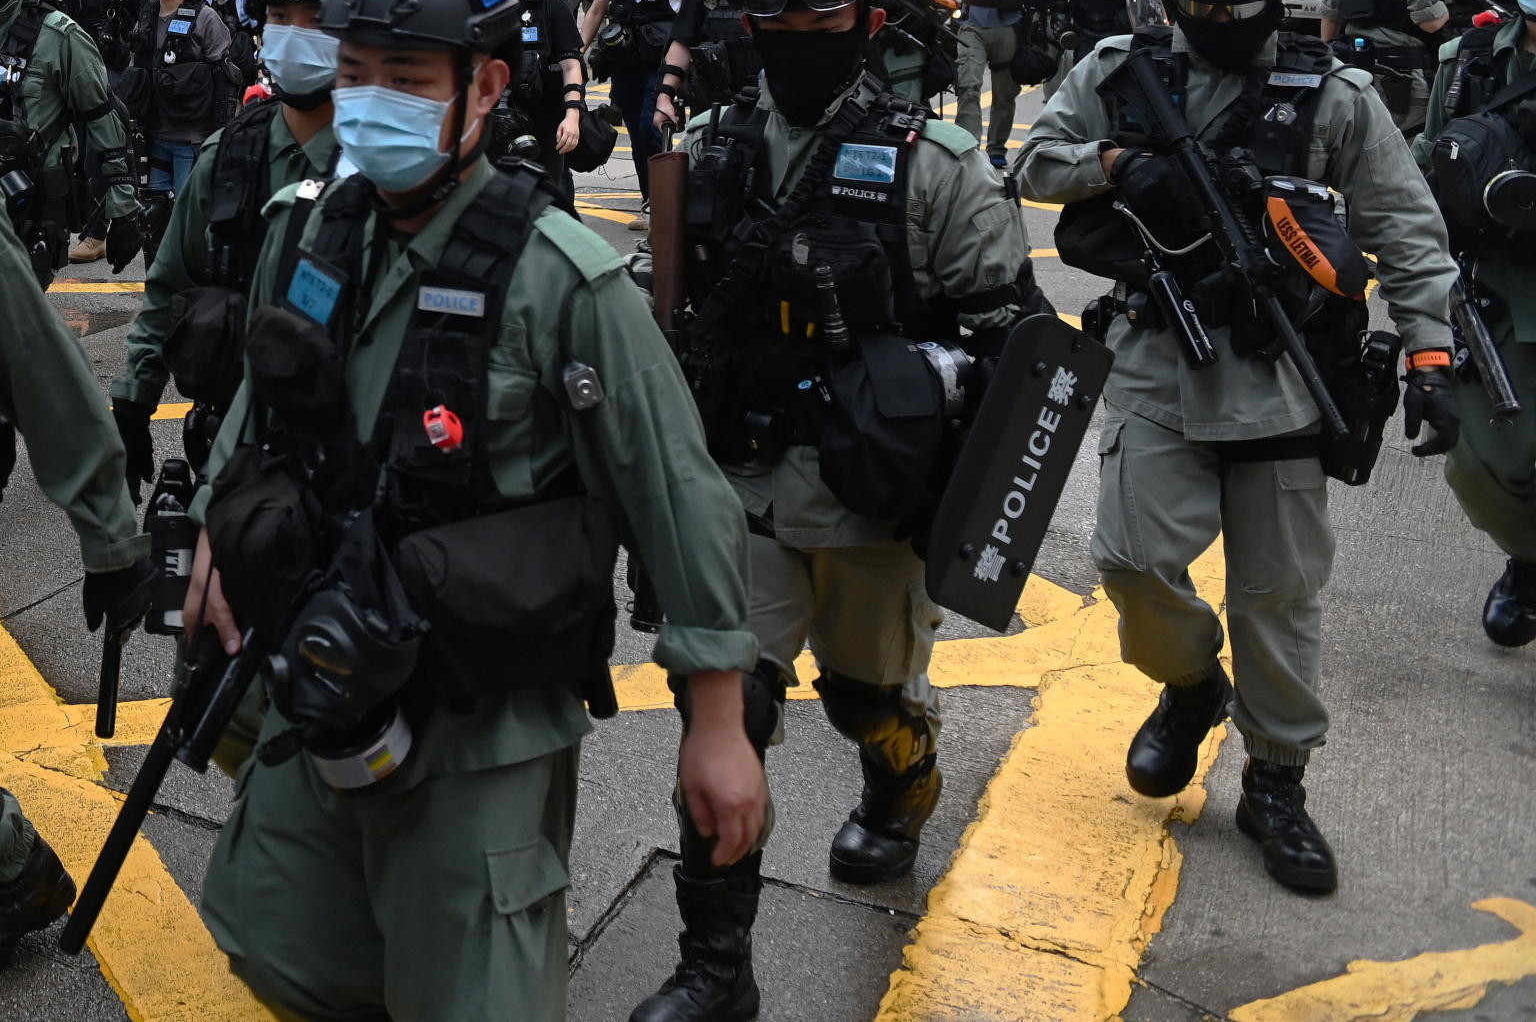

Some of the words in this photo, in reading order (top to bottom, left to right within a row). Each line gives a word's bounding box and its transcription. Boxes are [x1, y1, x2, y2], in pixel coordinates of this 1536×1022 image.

[841, 187, 877, 200] POLICE
[1277, 217, 1297, 242] LESS
[1290, 237, 1321, 270] LETHAL
[424, 292, 479, 311] POLICE
[991, 406, 1062, 545] POLICE
